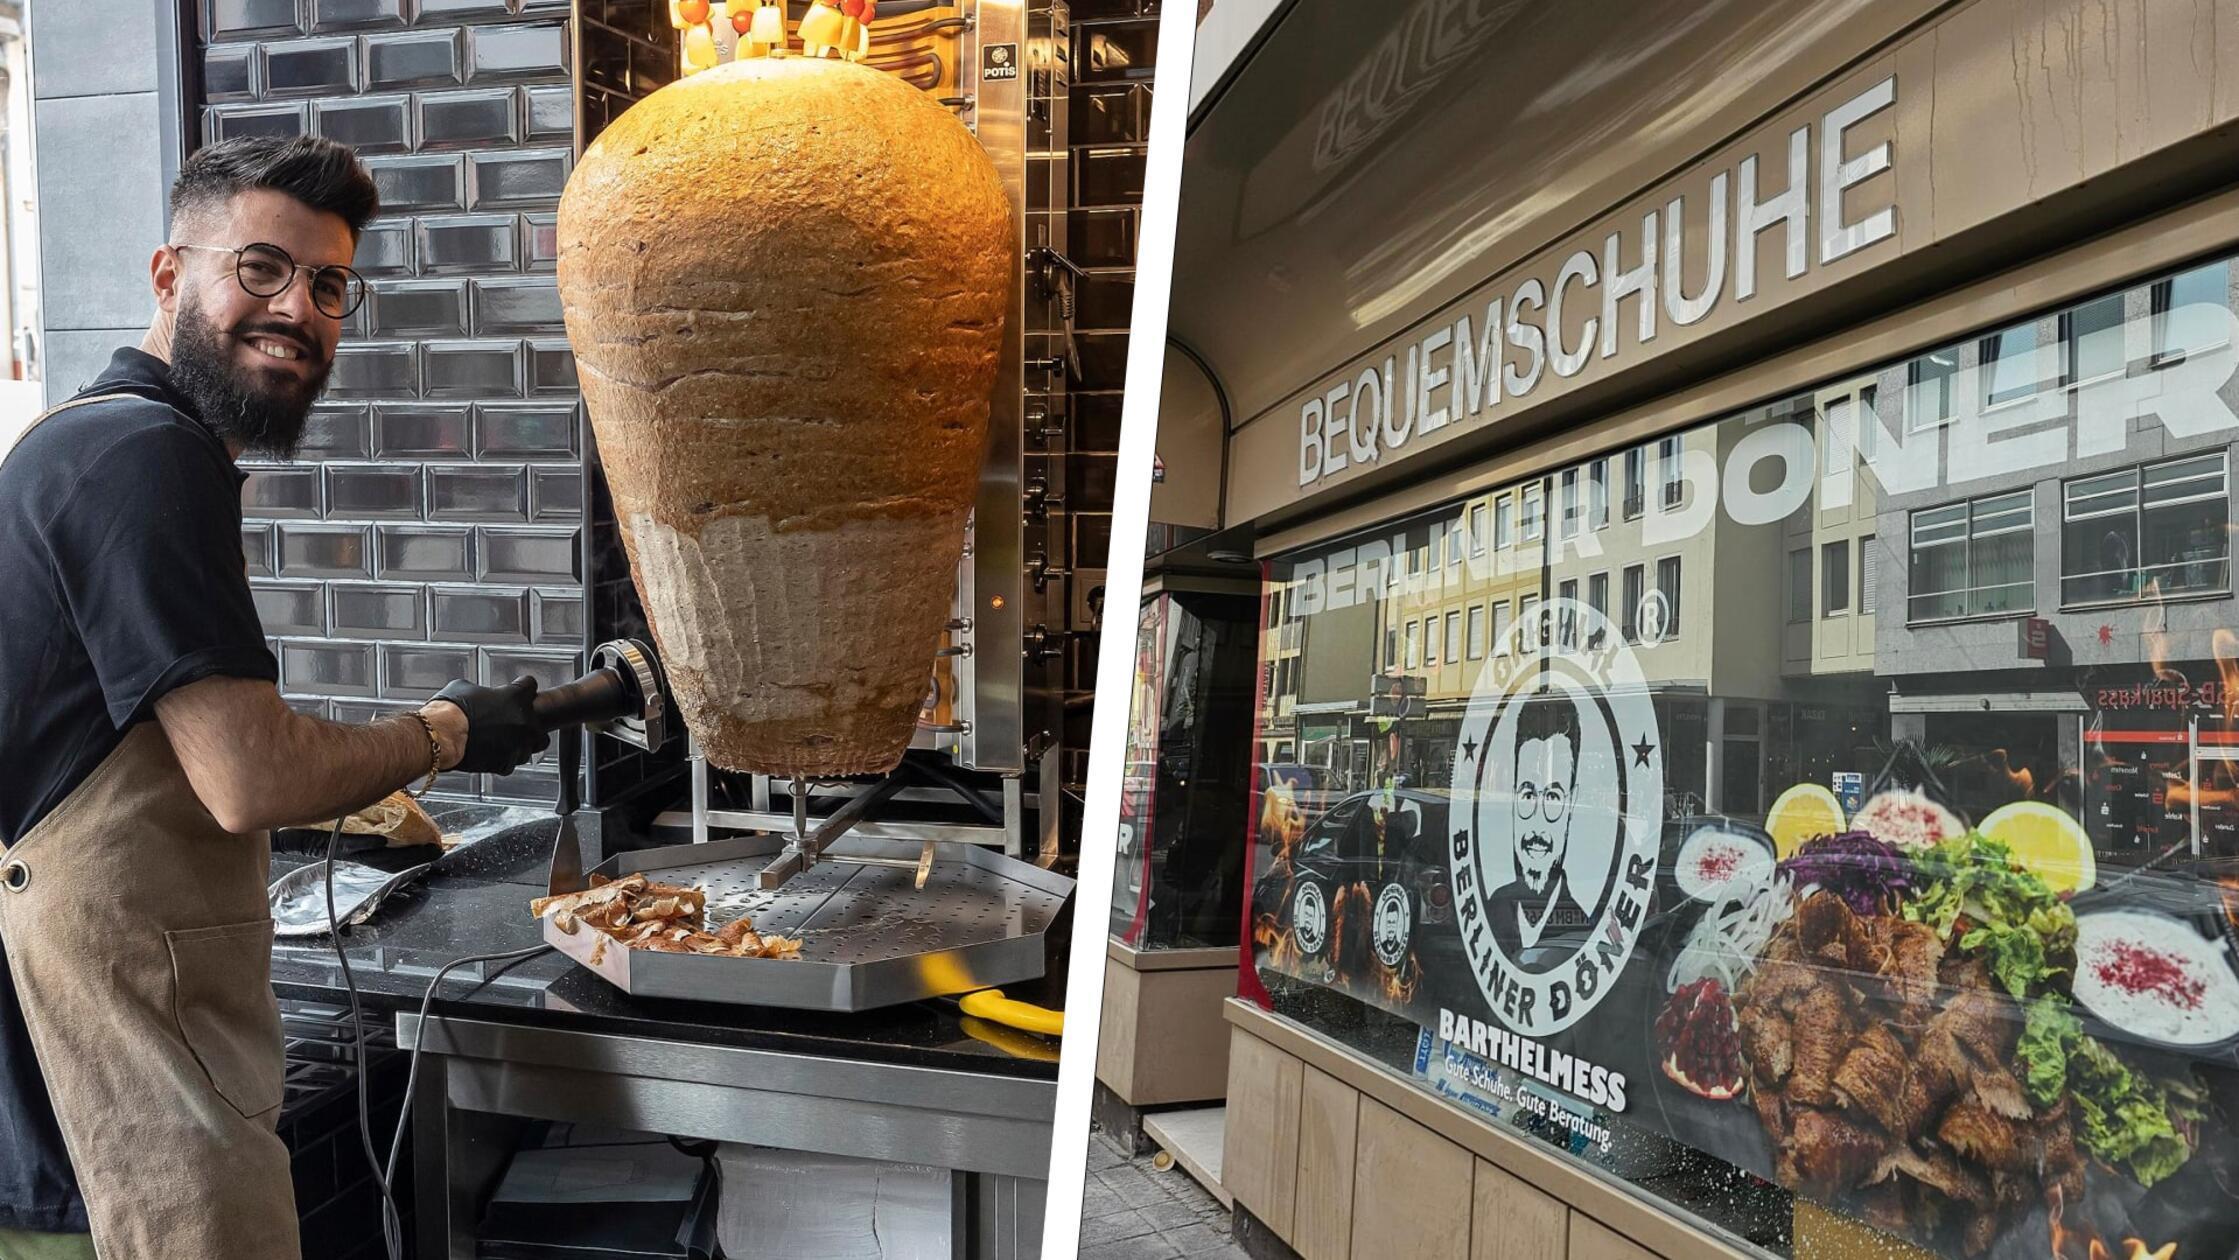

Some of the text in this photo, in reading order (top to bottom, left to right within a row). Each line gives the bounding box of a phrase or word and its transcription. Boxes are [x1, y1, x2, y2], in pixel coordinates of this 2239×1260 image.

[1299, 73, 1897, 486] BEQUEMSCHUHE
[1289, 302, 2239, 617] BERLINER DÖNER
[1493, 606, 1622, 692] ORIGINAL
[1453, 829, 1655, 1028] BERLINER DÖNER
[1439, 1007, 1626, 1113] BARTHELMESS
[1444, 1054, 1470, 1079] Gute
[1472, 1066, 1513, 1101] Schuhe,
[1516, 1086, 1546, 1117] Gute
[1549, 1099, 1613, 1153] Beratung.
